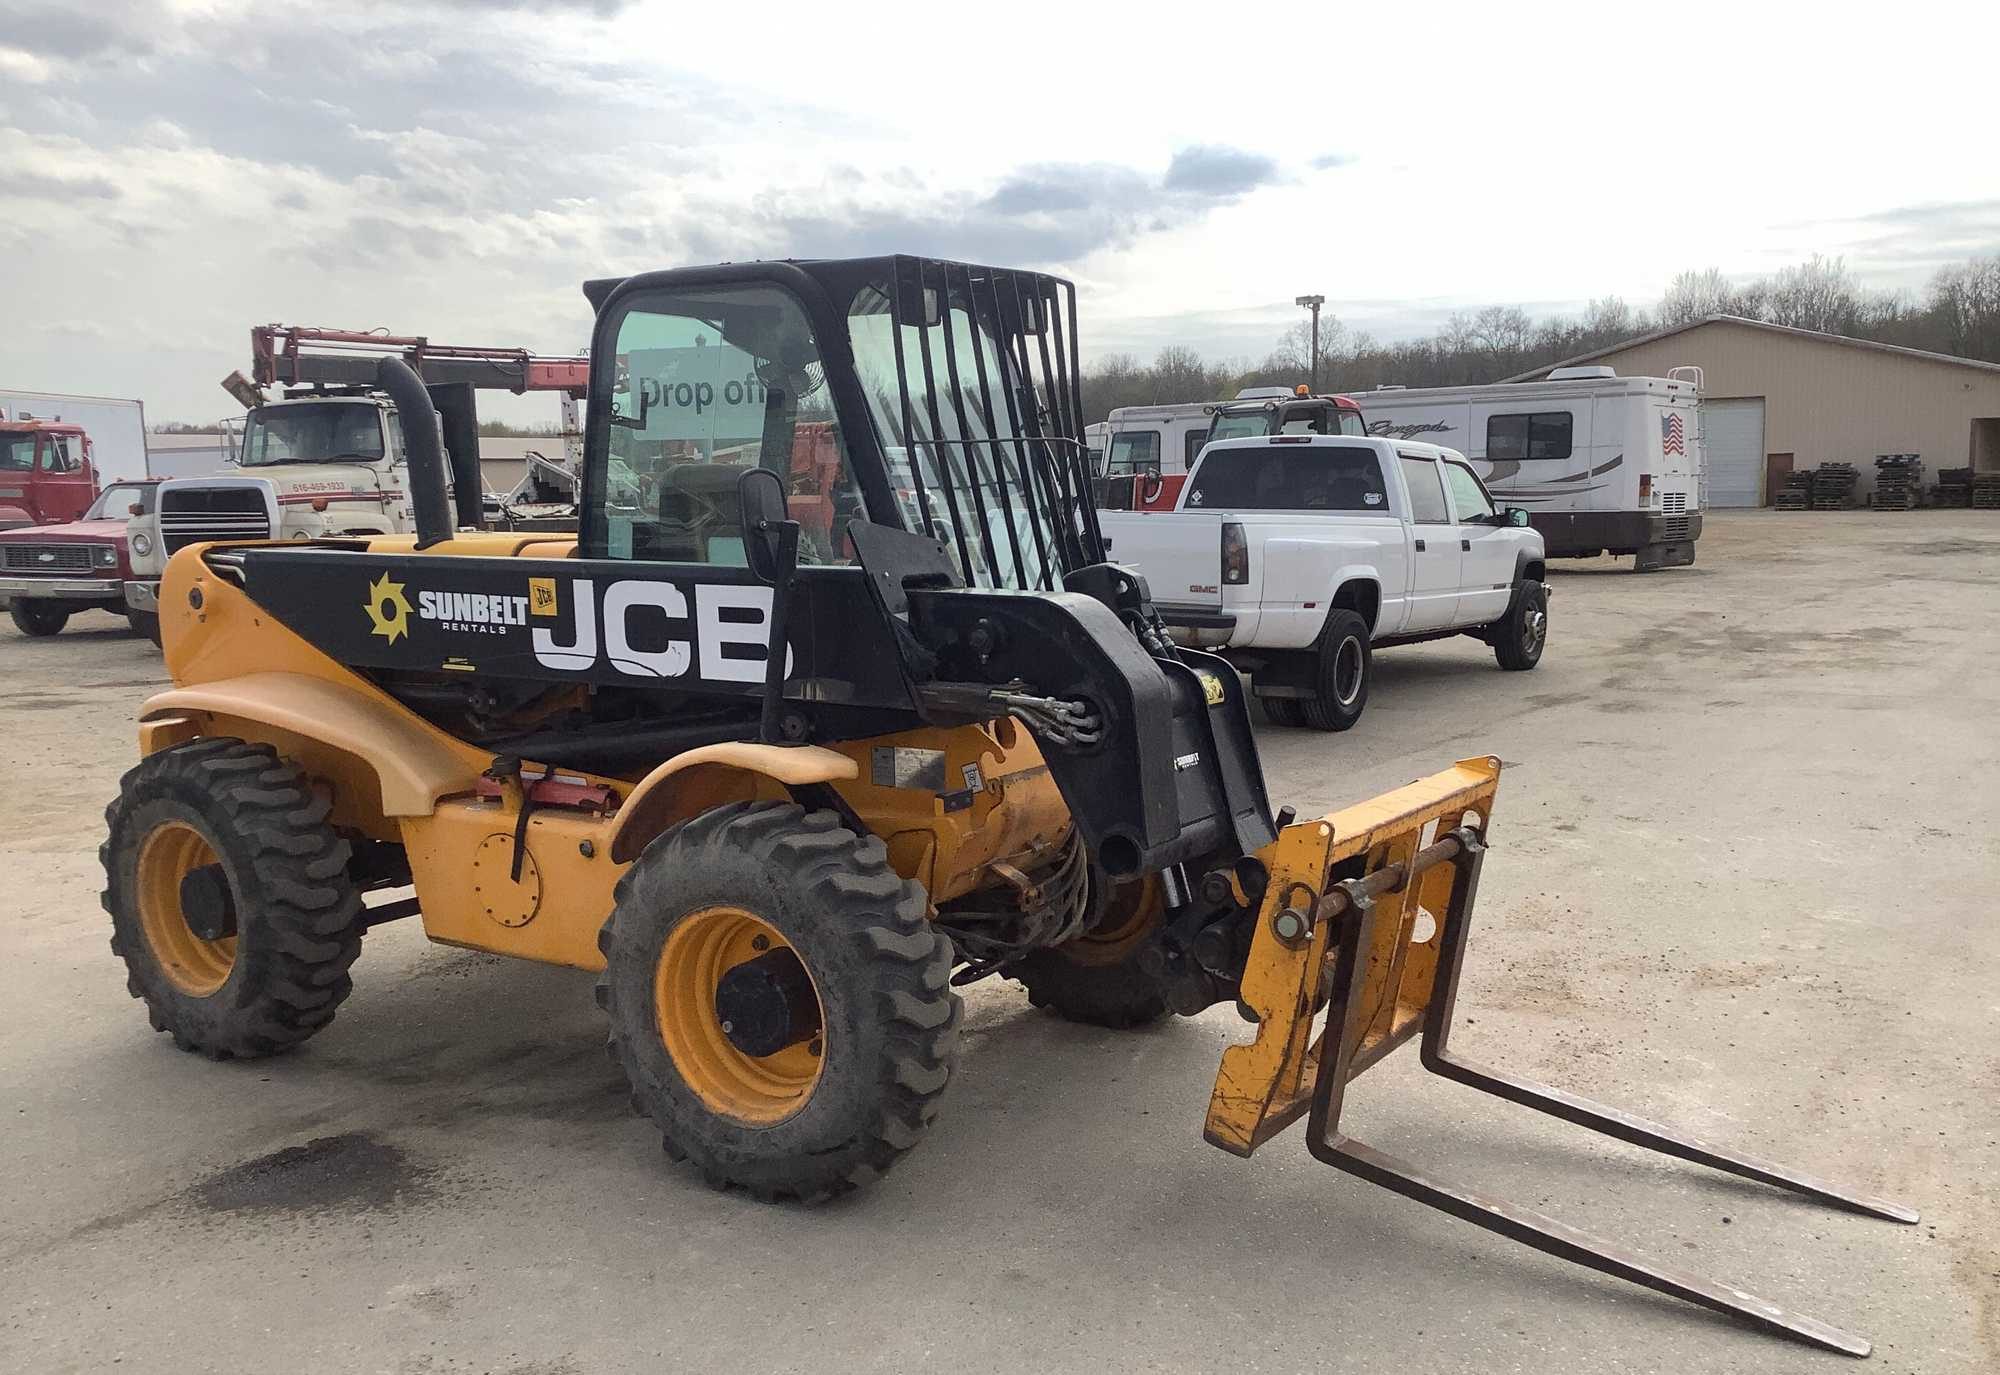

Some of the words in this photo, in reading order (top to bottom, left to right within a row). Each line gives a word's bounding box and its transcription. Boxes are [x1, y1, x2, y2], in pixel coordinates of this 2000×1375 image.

[639, 377, 714, 415] Drop
[418, 590, 529, 626] SUNBELT
[442, 622, 507, 635] RENTALS
[532, 579, 794, 683] JCB
